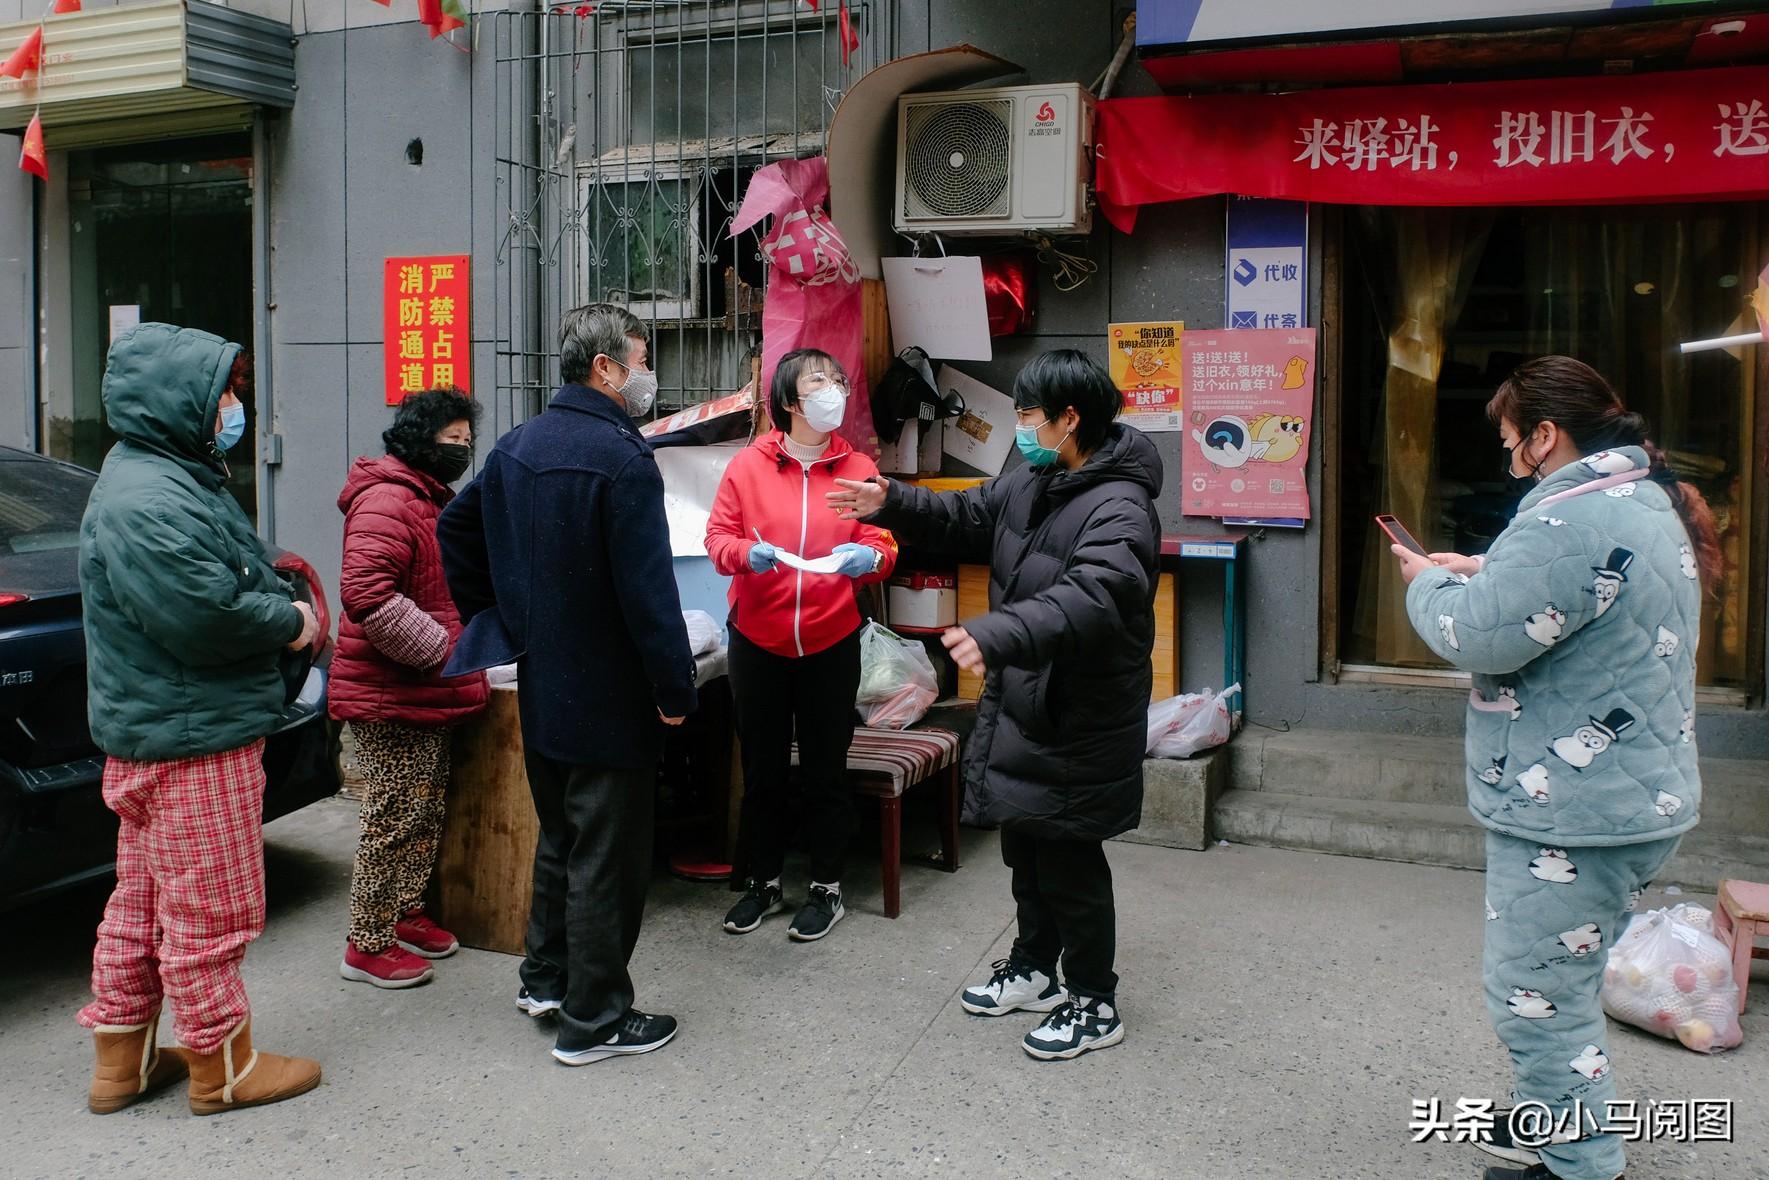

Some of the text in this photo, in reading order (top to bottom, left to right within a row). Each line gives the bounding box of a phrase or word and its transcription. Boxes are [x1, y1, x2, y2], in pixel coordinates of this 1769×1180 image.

[1264, 264, 1298, 282] 代收
[399, 264, 424, 392] 消防通道
[429, 264, 454, 390] 严禁占用
[1192, 379, 1273, 392] 过个xin意年！
